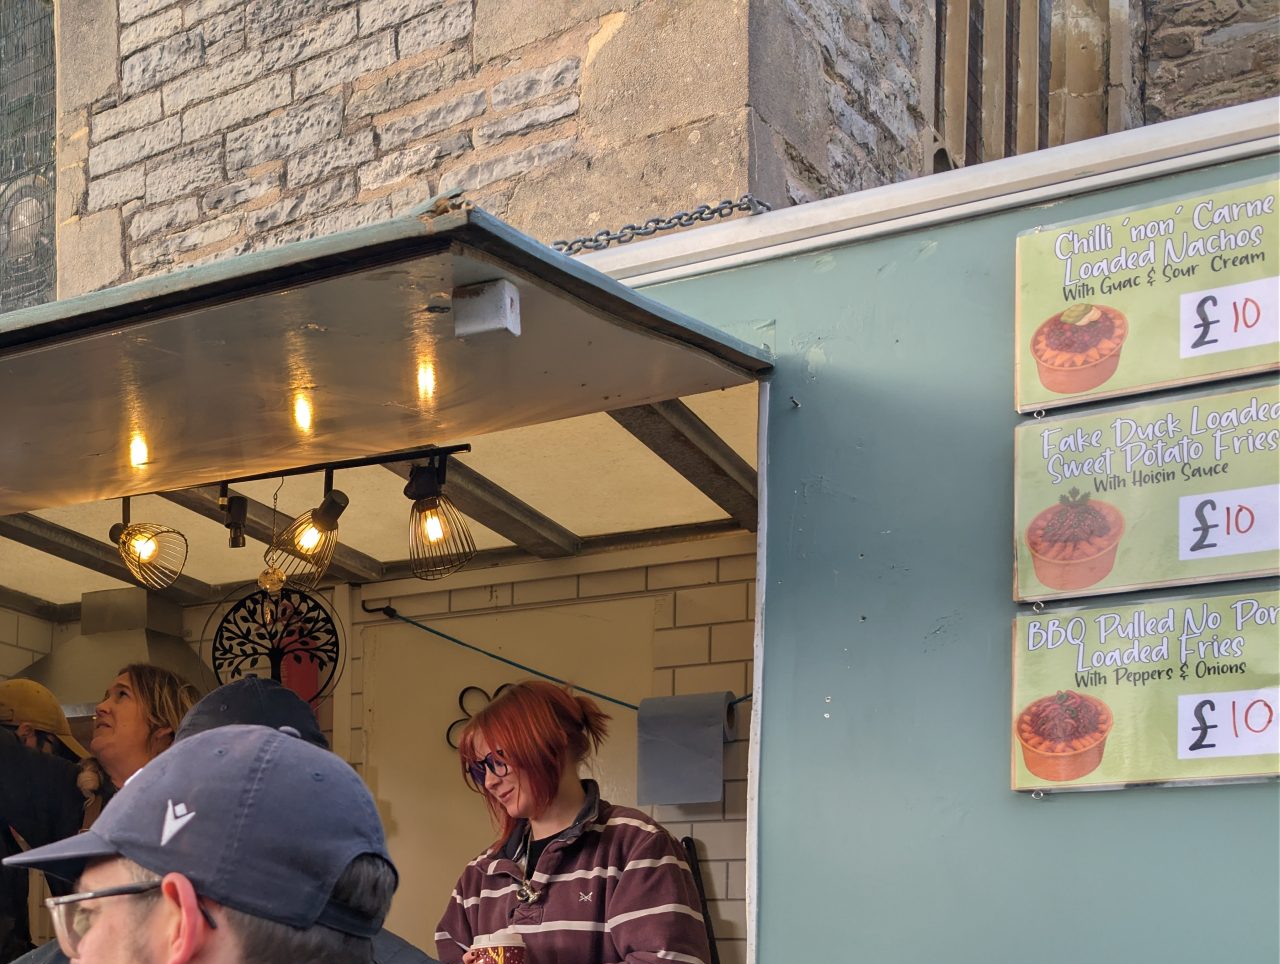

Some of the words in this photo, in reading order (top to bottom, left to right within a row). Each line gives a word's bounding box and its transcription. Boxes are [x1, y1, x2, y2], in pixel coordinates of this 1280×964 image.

[1054, 222, 1113, 262] Chilli
[1192, 195, 1275, 231] Carne
[1062, 283, 1095, 302] With
[1100, 275, 1141, 295] Guac
[1147, 267, 1156, 287] &
[1162, 262, 1200, 284] Sour
[1211, 251, 1265, 273] Cream
[1064, 240, 1155, 286] Loaded
[1163, 225, 1264, 266] Nachos
[1191, 294, 1261, 349] £10
[1040, 427, 1103, 460] Fake
[1111, 413, 1181, 447] Duck
[1047, 446, 1116, 486] Sweet
[1120, 434, 1203, 474] Potato
[1212, 425, 1280, 462] Fries
[1093, 473, 1127, 494] With
[1131, 468, 1176, 488] Hoisin
[1180, 461, 1229, 482] Sauce
[1189, 498, 1256, 552] £10
[1027, 617, 1086, 651] BBQ
[1094, 607, 1175, 644] Pulled
[1182, 603, 1222, 637] No
[1076, 636, 1169, 673] Loaded
[1178, 631, 1246, 664] Fries
[1074, 671, 1108, 688] With
[1113, 665, 1174, 687] Peppers
[1179, 660, 1190, 681] &
[1195, 659, 1247, 679] Onions
[1189, 699, 1274, 752] £10
